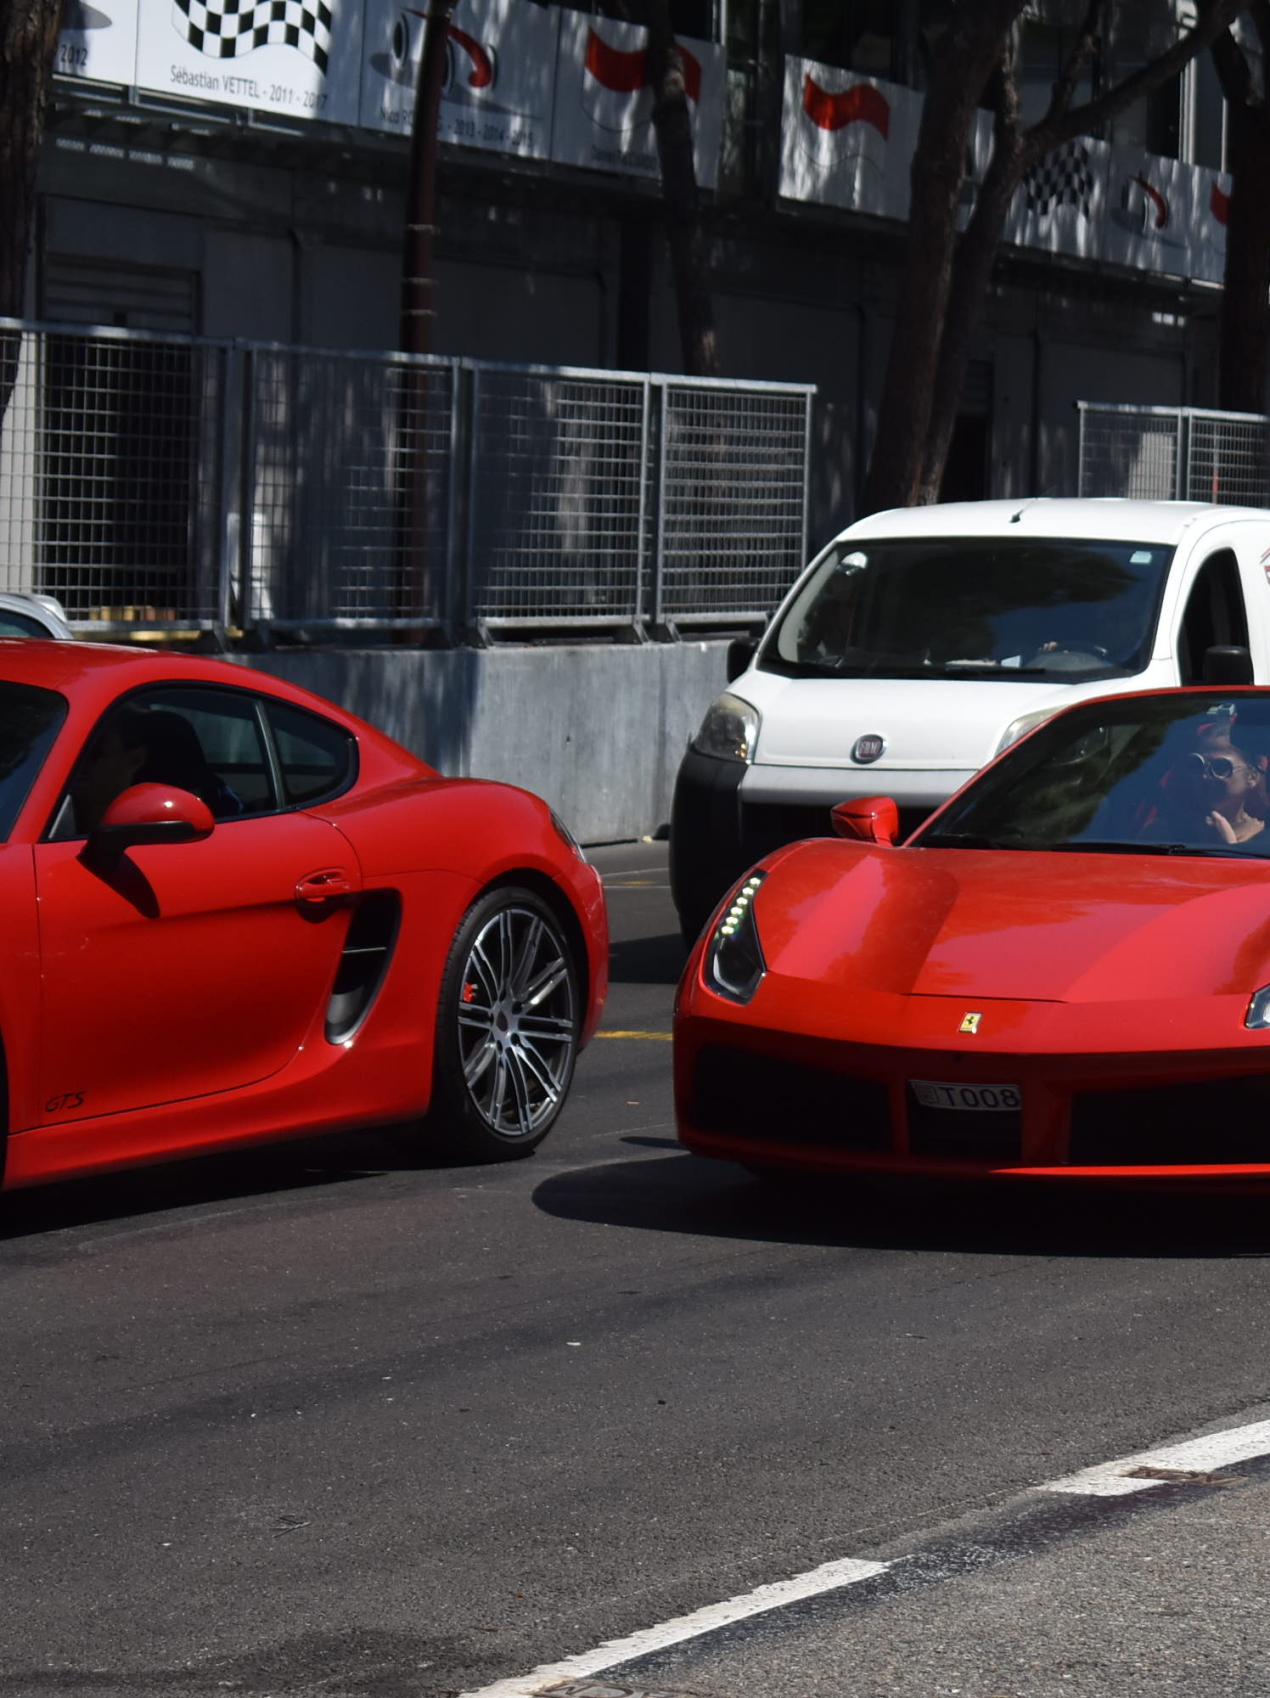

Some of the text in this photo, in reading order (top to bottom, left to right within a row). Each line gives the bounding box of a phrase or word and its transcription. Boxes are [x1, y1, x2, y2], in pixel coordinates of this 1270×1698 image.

[60, 44, 88, 66] 2012
[170, 64, 219, 90] Sébastian
[222, 75, 260, 99] VETTEL
[270, 84, 293, 103] 2011
[45, 1091, 86, 1113] GTS
[938, 1086, 1020, 1108] T008
